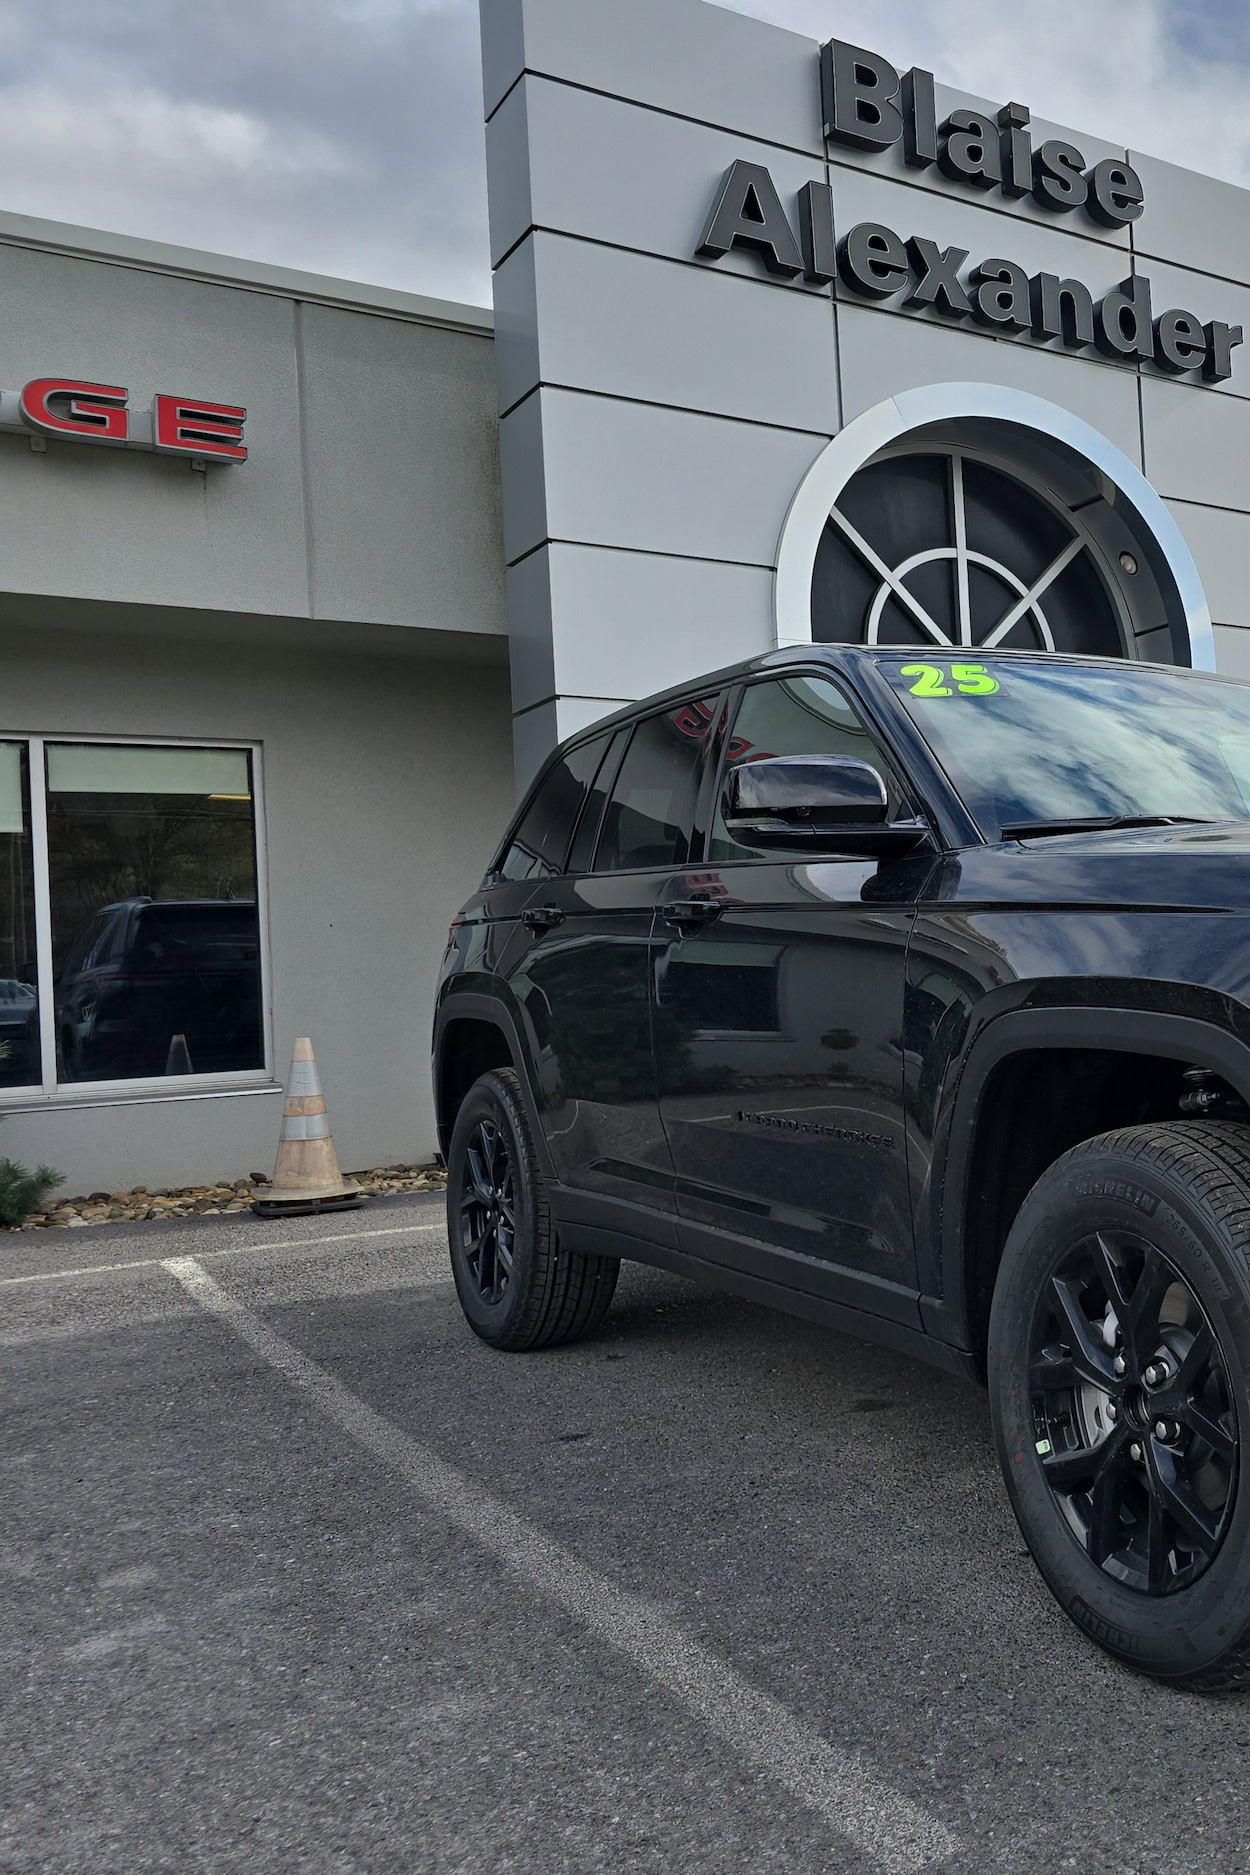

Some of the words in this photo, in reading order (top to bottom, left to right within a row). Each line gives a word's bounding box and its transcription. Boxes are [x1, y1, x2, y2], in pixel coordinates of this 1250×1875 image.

[821, 37, 1144, 229] Blaise
[695, 159, 1243, 383] Alexander
[901, 664, 1000, 697] 25
[1166, 1214, 1203, 1258] 265/60
[1201, 1262, 1211, 1273] R
[1209, 1277, 1223, 1292] 18
